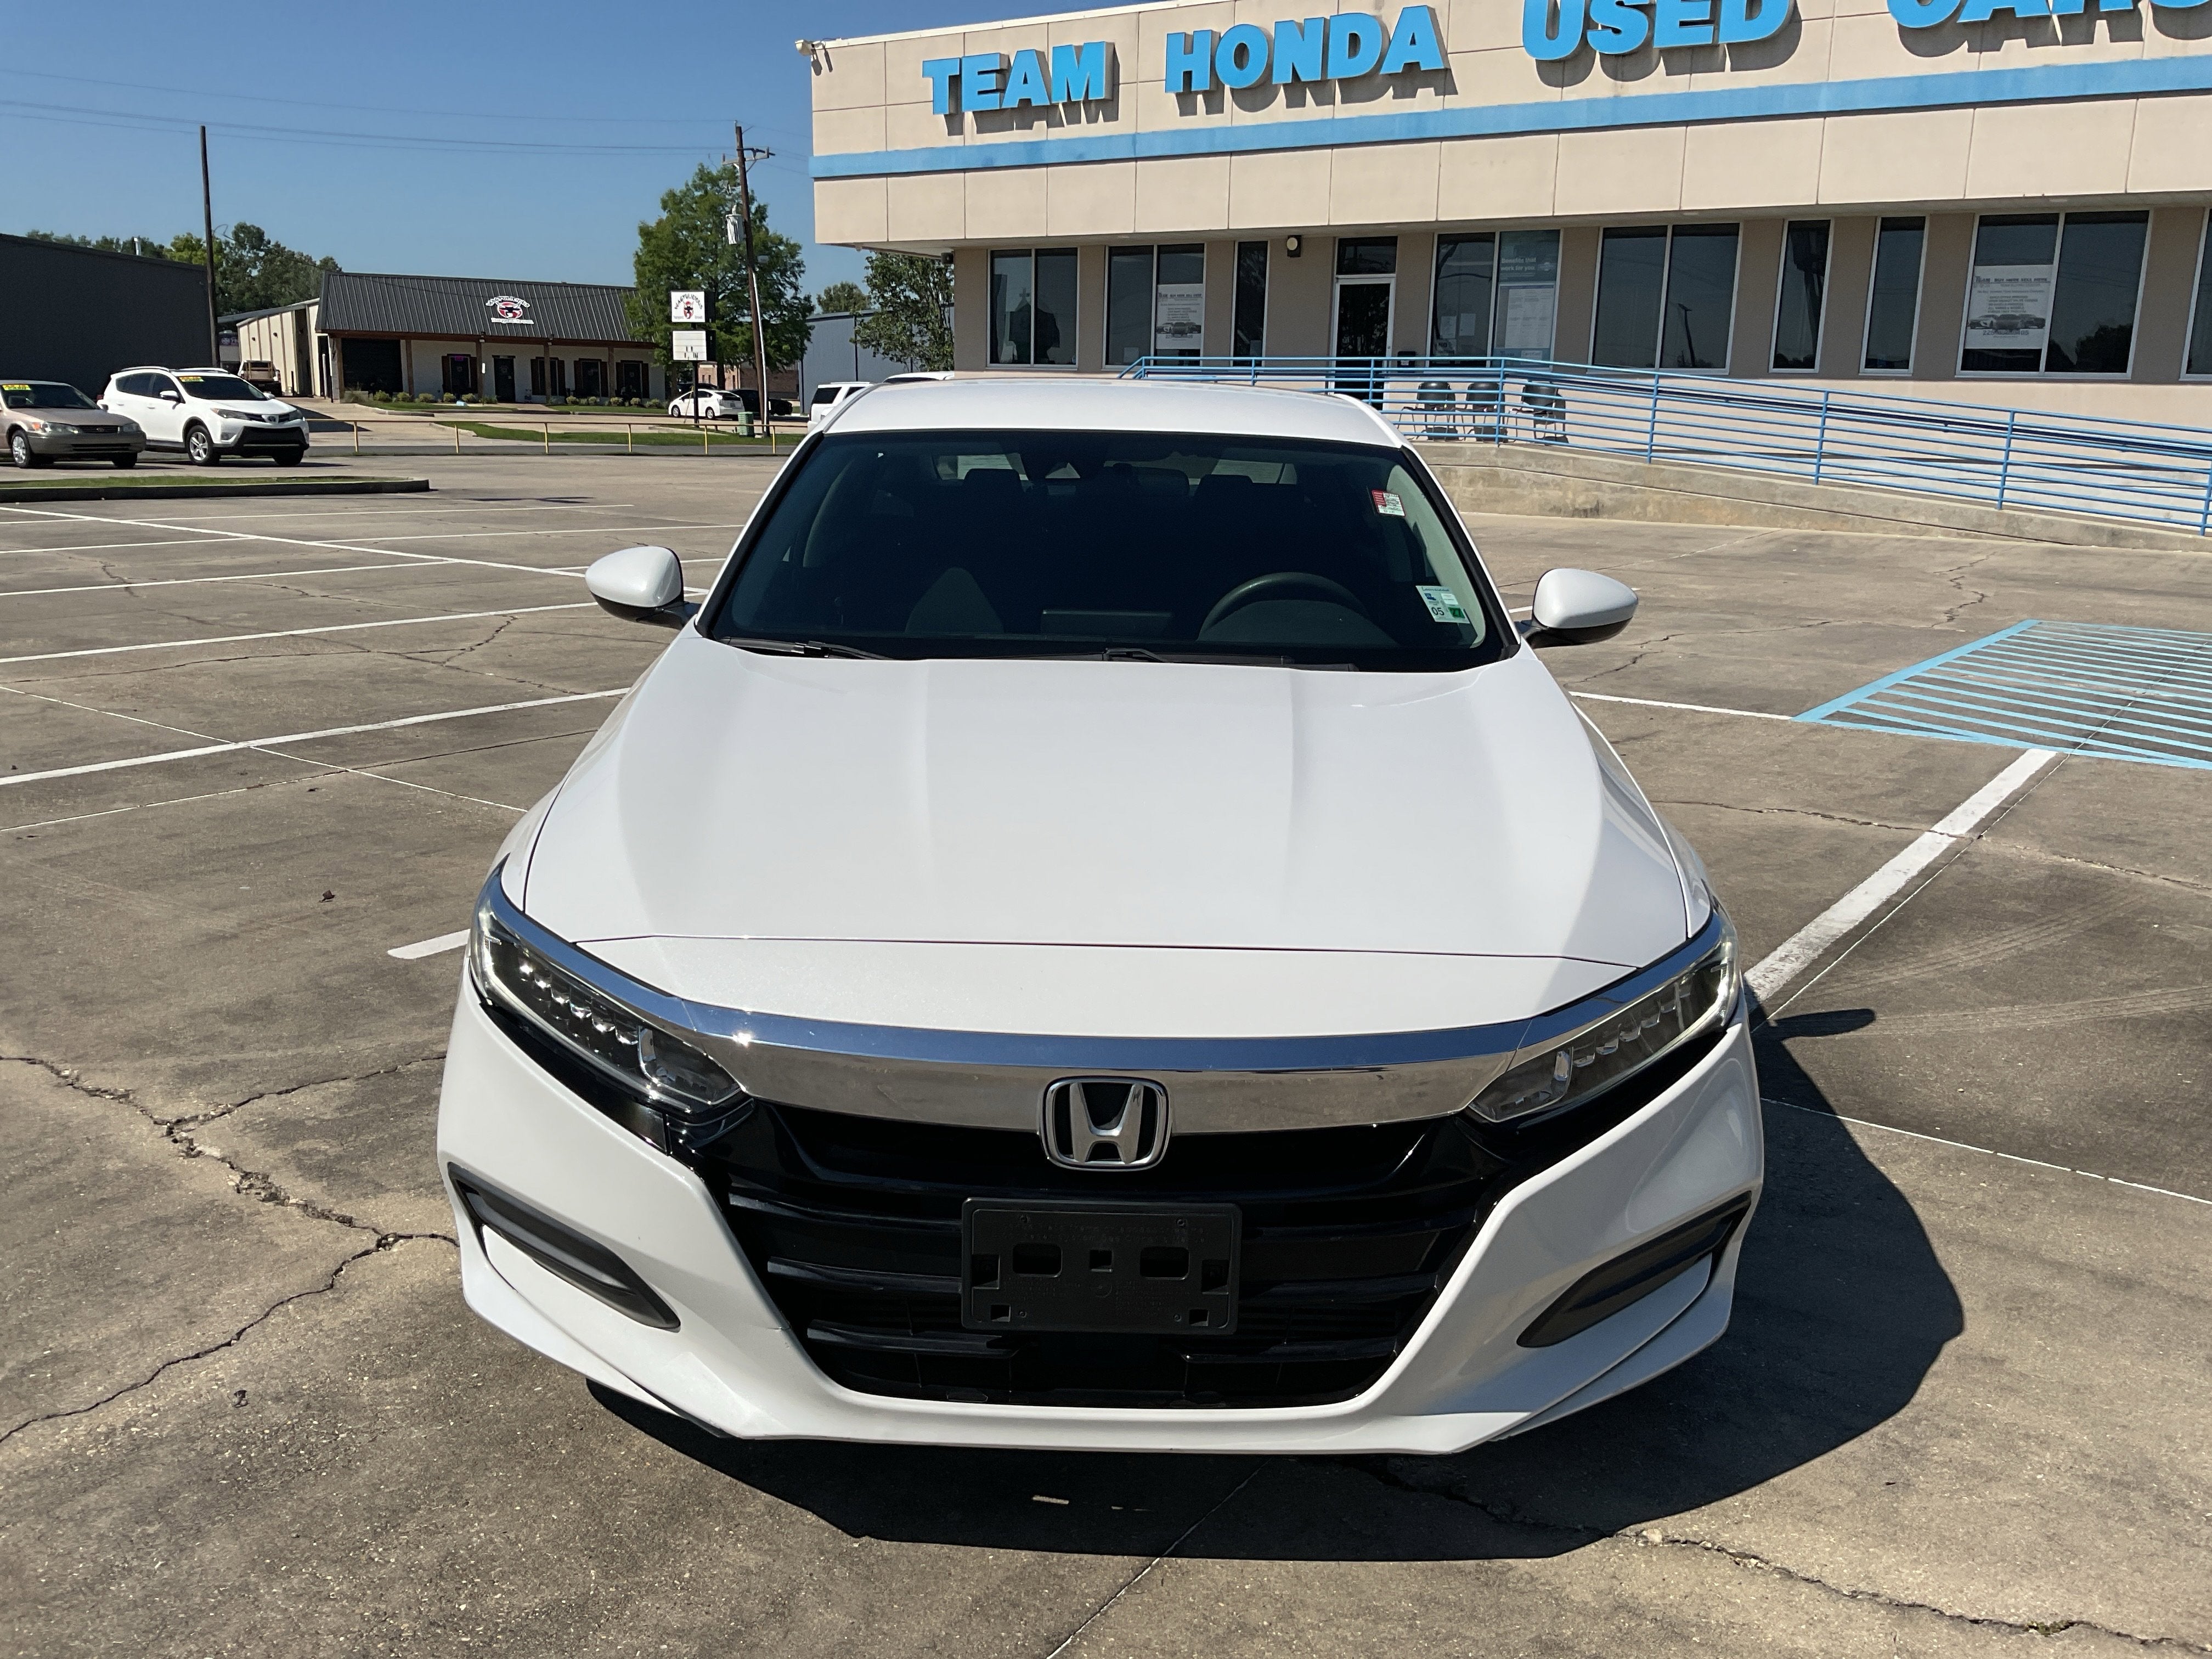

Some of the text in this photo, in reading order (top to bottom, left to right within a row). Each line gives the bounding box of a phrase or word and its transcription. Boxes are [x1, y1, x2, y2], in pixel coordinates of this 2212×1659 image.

[922, 0, 1792, 115] TEAM HONDA USED
[1431, 607, 1444, 616] 05
